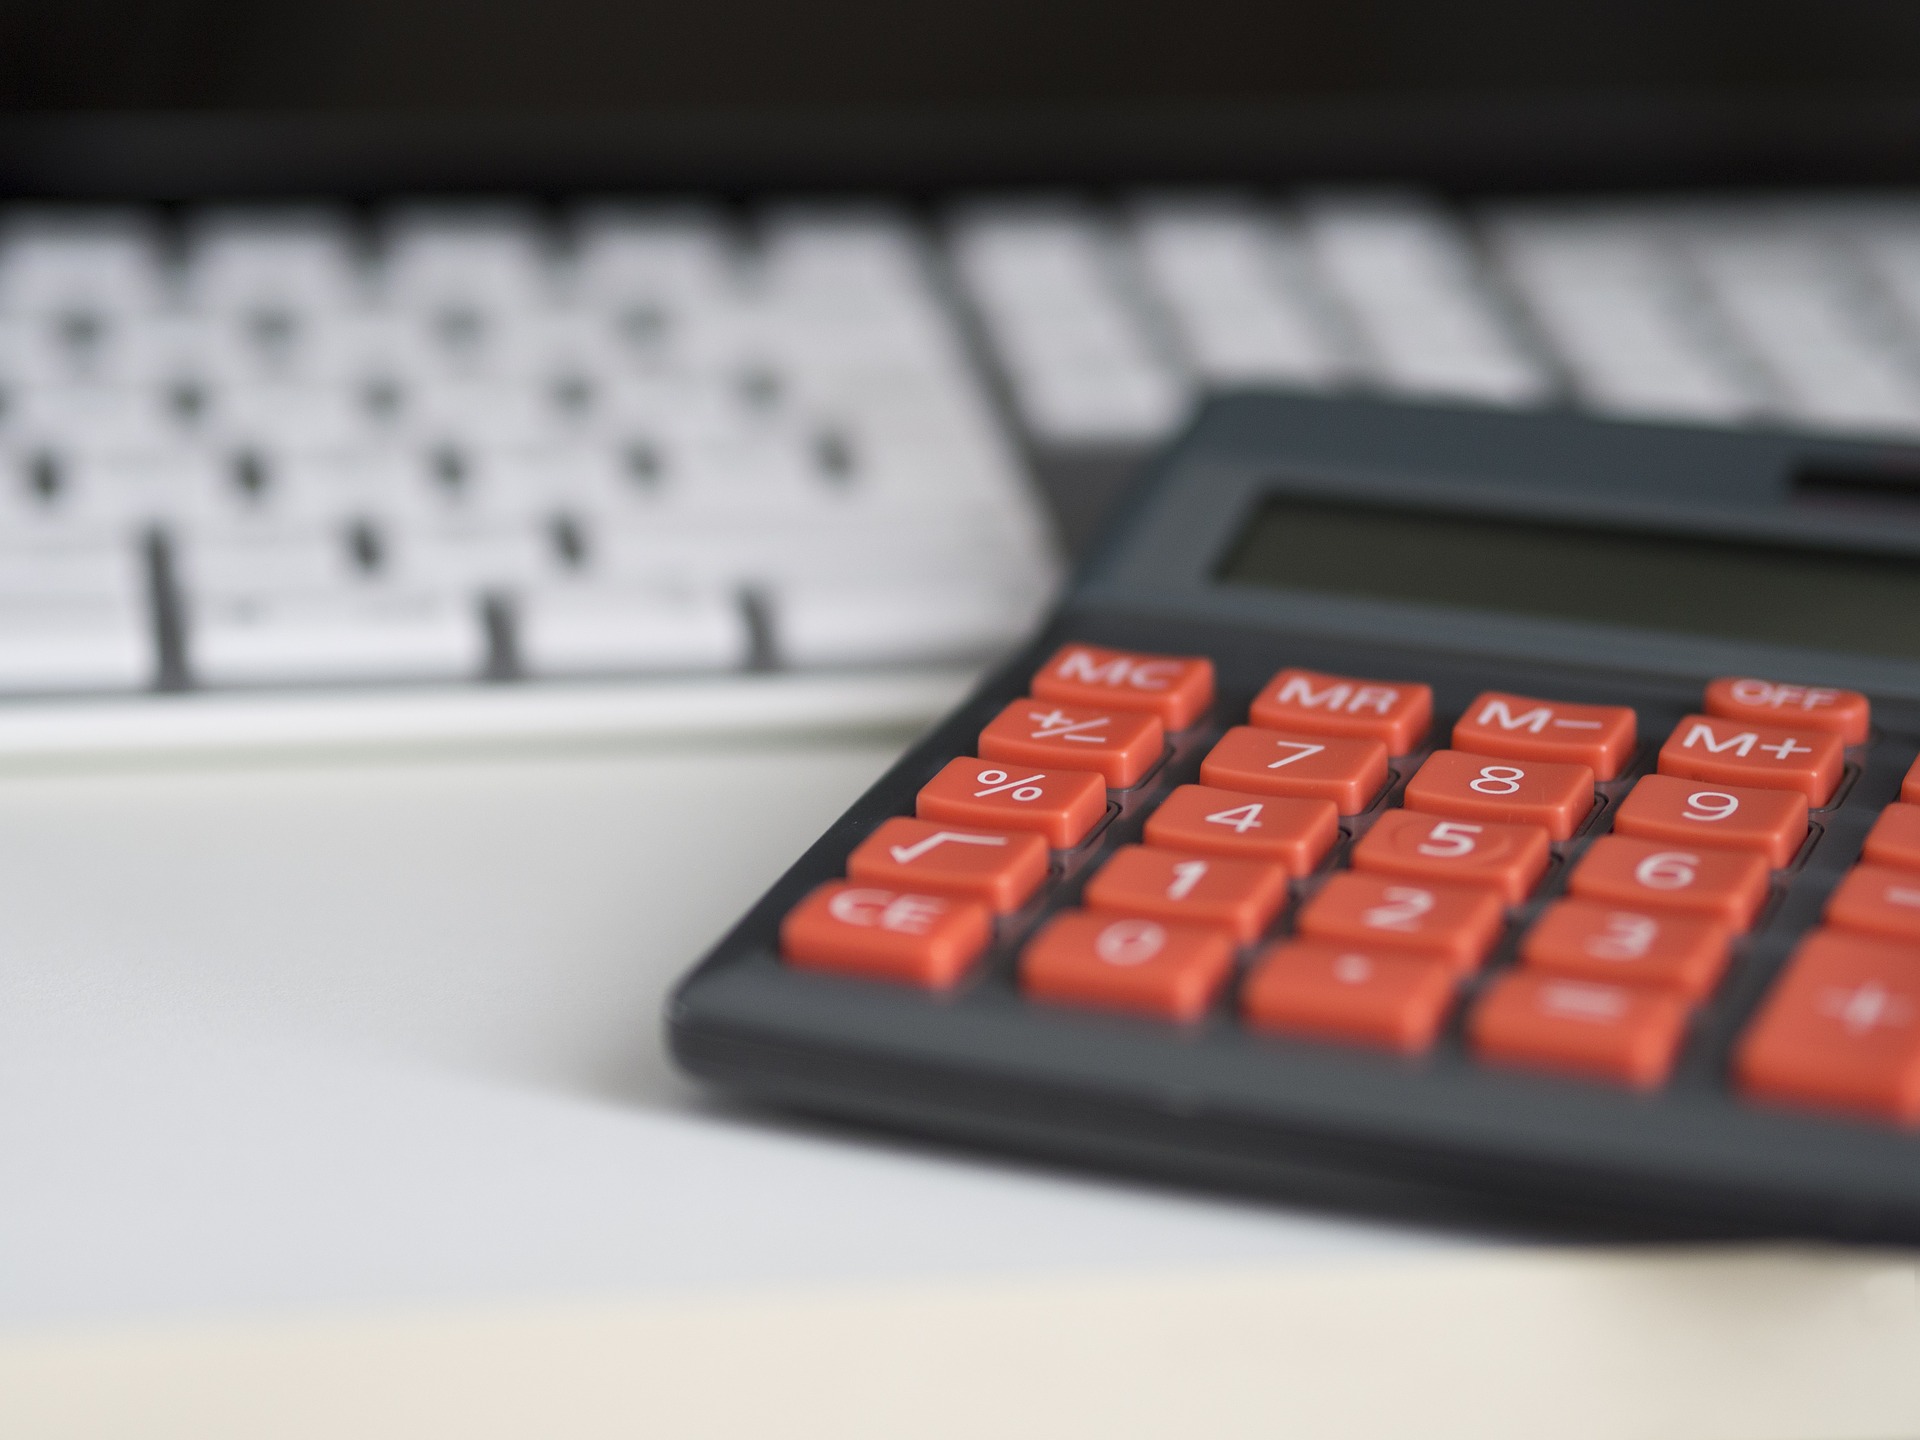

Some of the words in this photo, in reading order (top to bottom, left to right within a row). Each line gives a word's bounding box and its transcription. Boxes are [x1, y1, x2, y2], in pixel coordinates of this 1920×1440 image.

[1058, 651, 1182, 689] MC
[1278, 677, 1399, 714] MR
[1731, 679, 1841, 710] OFF
[1267, 741, 1325, 768] 7
[1682, 724, 1812, 760] M+
[974, 770, 1045, 801] %
[1470, 766, 1524, 794] 8
[1205, 804, 1263, 832] 4
[1681, 792, 1739, 821] 9
[1418, 822, 1483, 857] 5
[1166, 860, 1208, 900] 1
[1635, 852, 1700, 890] 6
[828, 888, 947, 935] CE
[1362, 886, 1435, 932] 2
[1095, 919, 1165, 966] 0
[1586, 912, 1658, 960] 3
